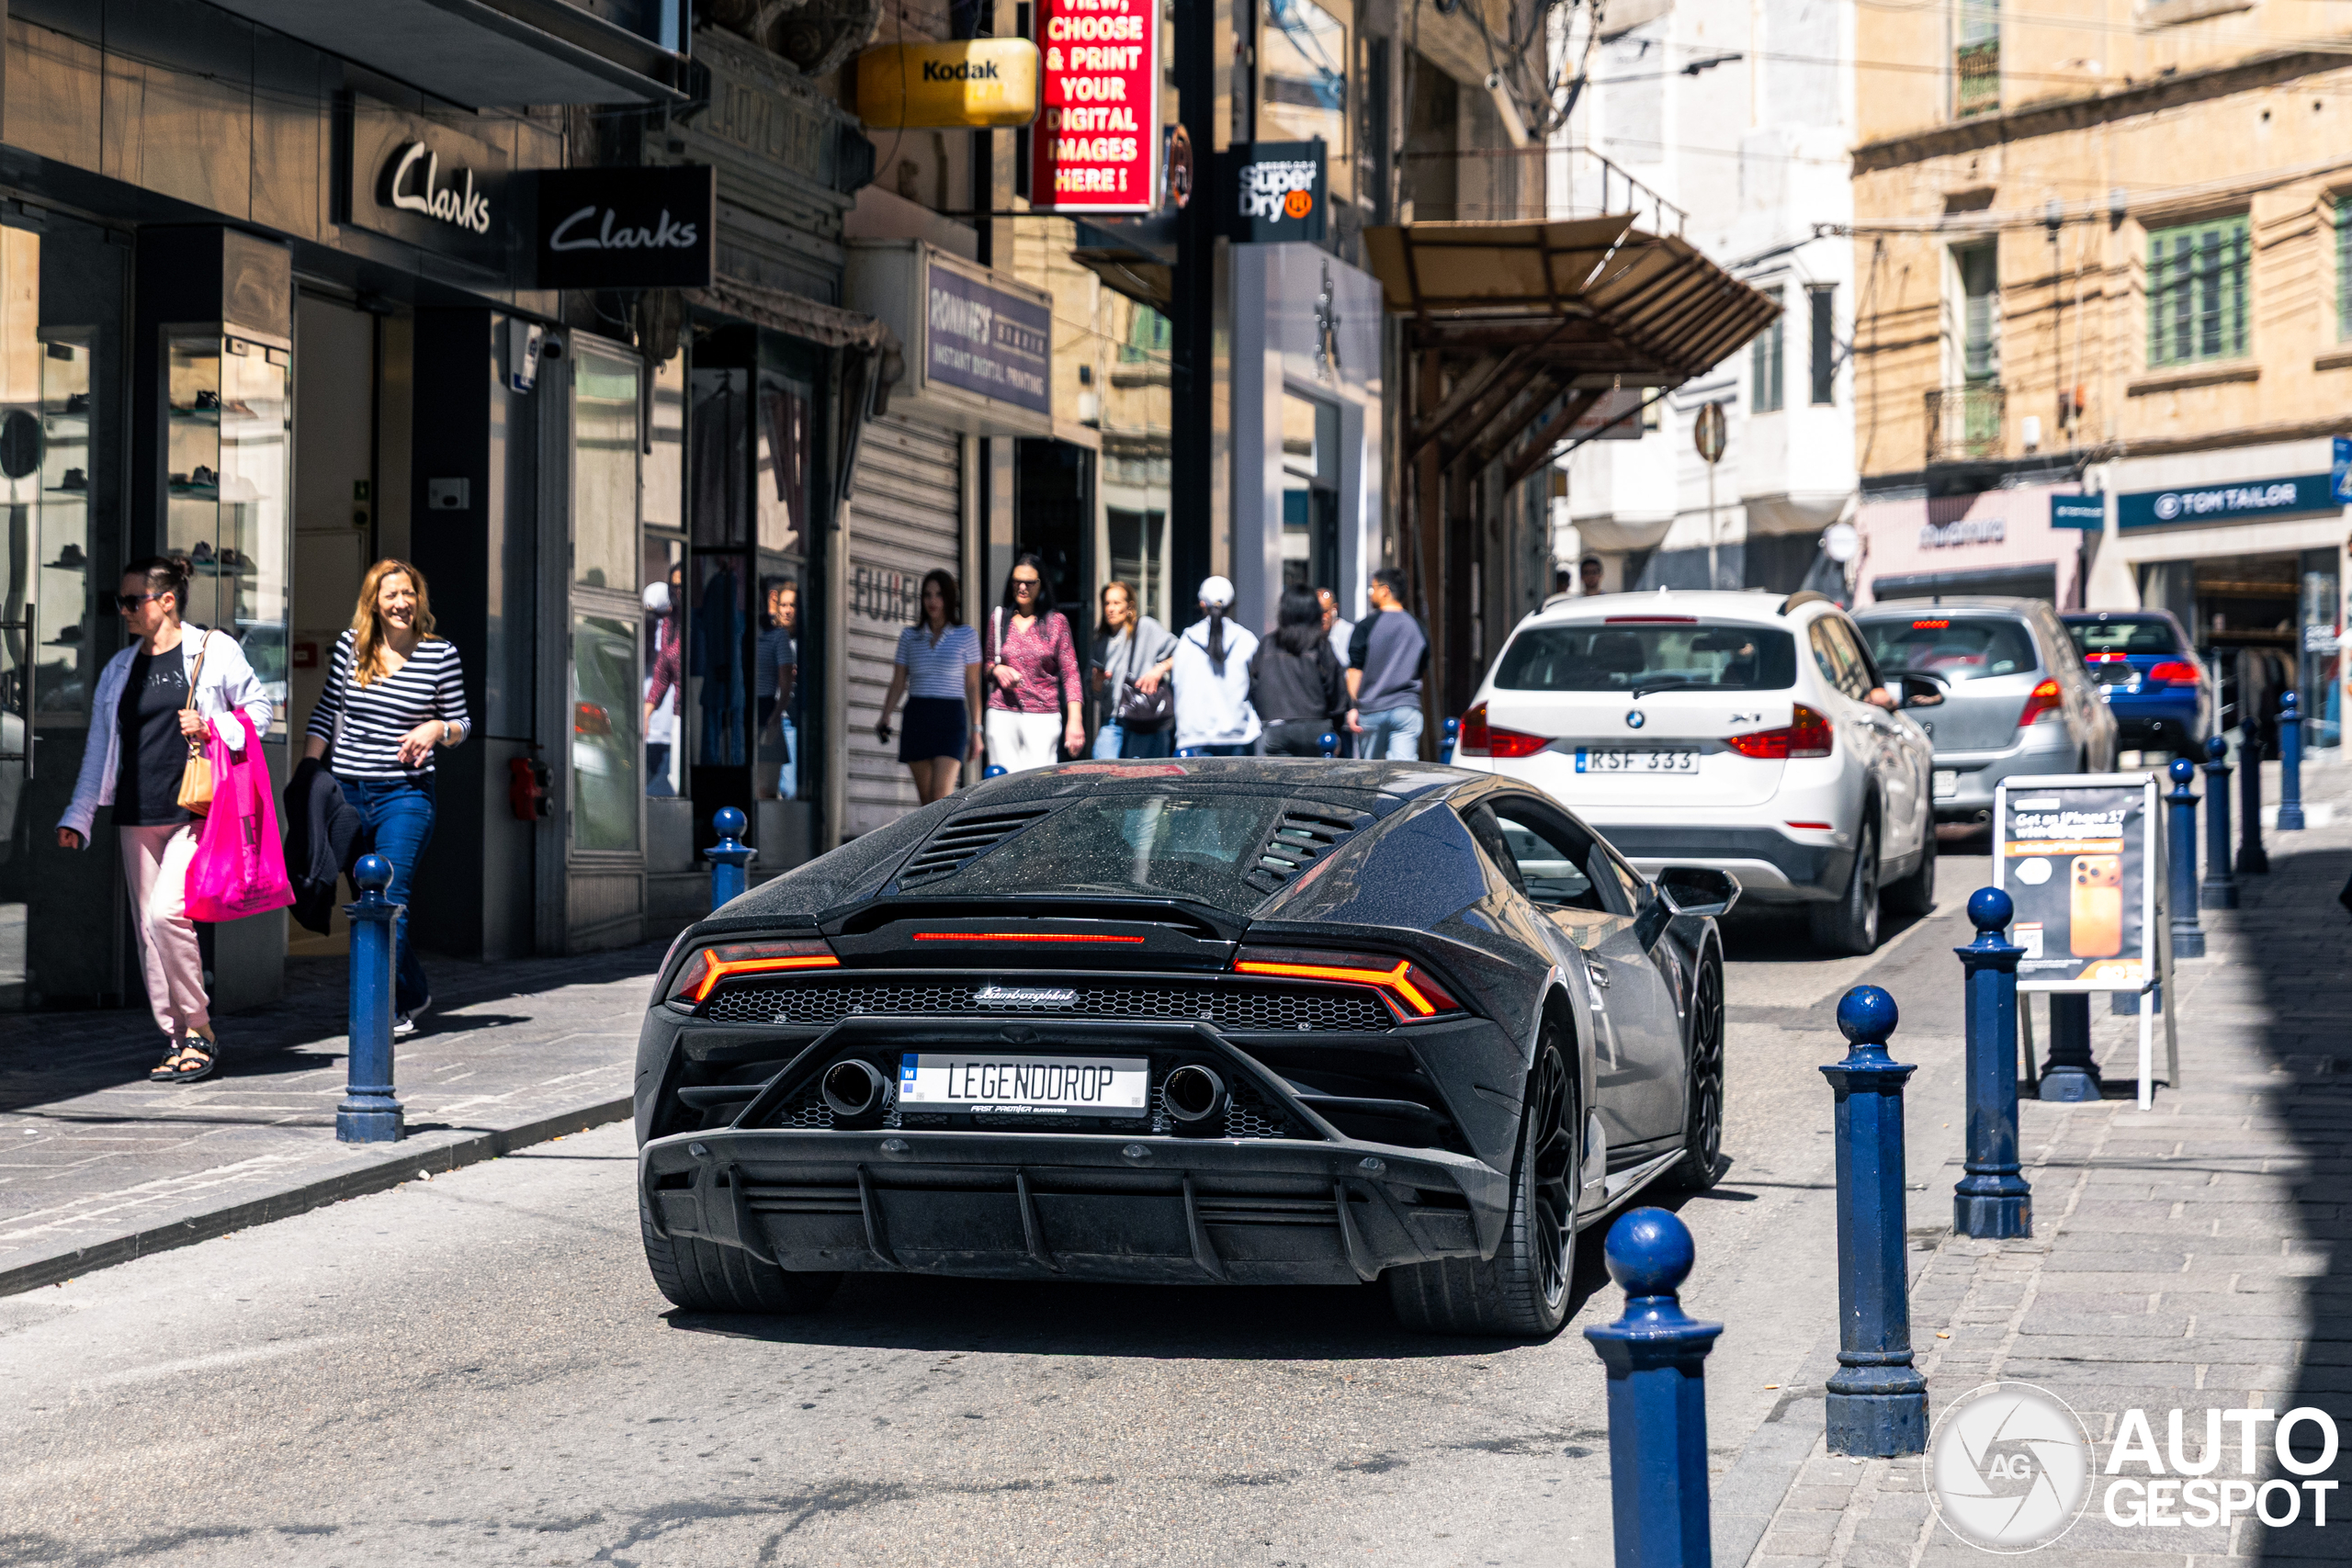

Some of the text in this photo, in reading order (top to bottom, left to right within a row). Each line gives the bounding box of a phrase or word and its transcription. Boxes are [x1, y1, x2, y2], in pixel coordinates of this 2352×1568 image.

[1047, 16, 1144, 41] CHOOSE
[923, 59, 999, 81] Kodak
[1046, 46, 1142, 71] & PRINT
[1060, 76, 1127, 102] YOUR
[1046, 107, 1138, 131] DIGITAL
[1047, 138, 1138, 162] IMAGES
[392, 141, 490, 234] Clarks
[1238, 165, 1317, 196] Super
[550, 204, 697, 251] Clarks
[2181, 482, 2297, 515] TOM TAILOR
[1591, 748, 1691, 769] RSF 333
[2015, 813, 2041, 827] Get
[2108, 809, 2126, 823] 17
[974, 986, 1074, 1003] Lamborghini
[905, 1069, 914, 1079] M
[948, 1063, 1114, 1102] LEGENDDROP
